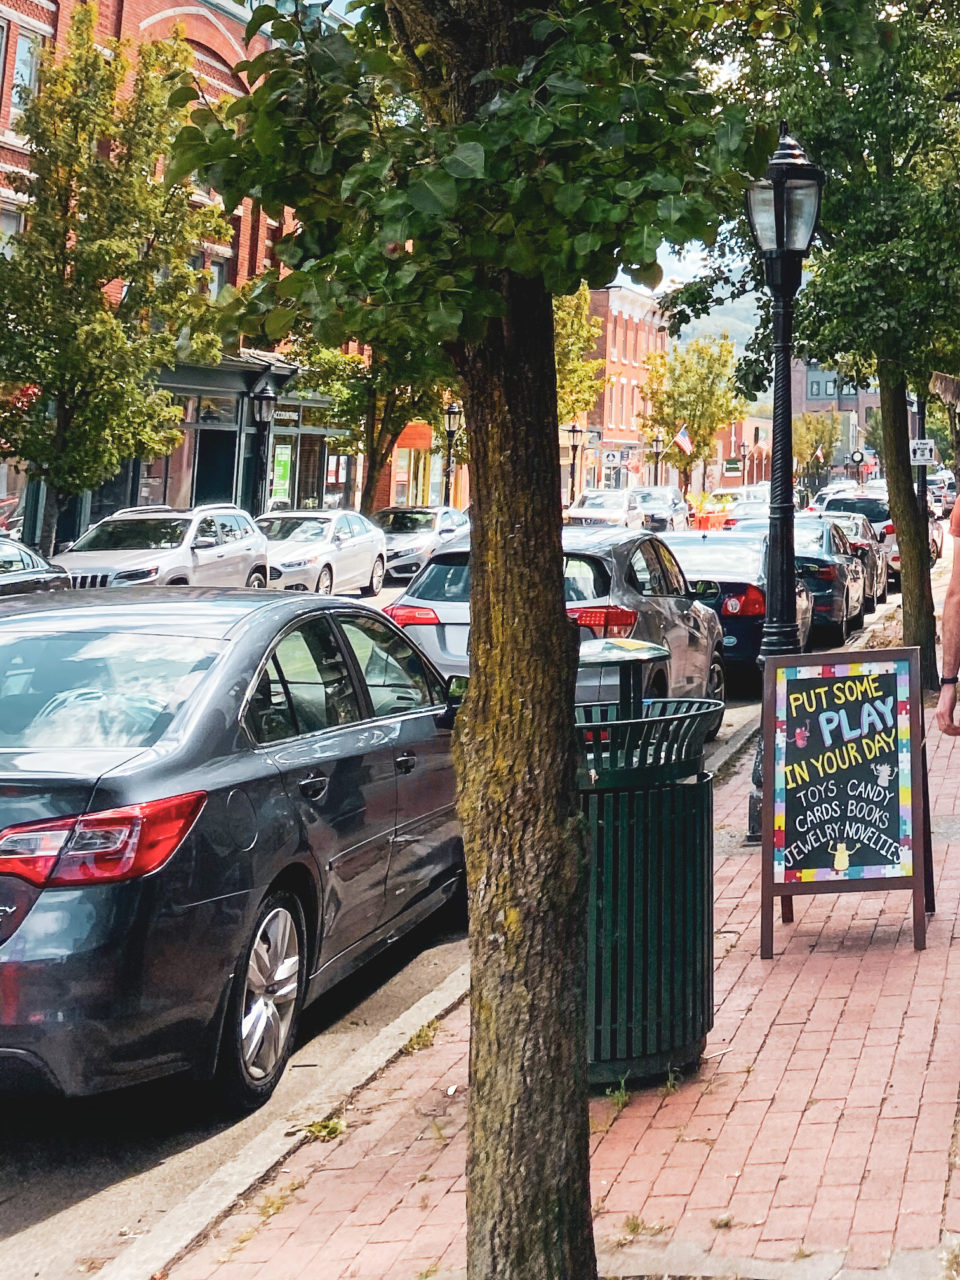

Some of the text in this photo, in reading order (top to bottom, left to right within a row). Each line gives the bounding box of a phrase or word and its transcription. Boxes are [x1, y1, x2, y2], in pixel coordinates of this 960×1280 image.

[789, 674, 883, 717] PUT SOME
[818, 696, 894, 747] PLAY
[784, 729, 895, 789] IN YOUR DAY
[796, 780, 894, 806] TOYS CANDY
[796, 800, 889, 831] CARDS BOOKS
[782, 821, 901, 867] JEWELRY NOVELTIES
